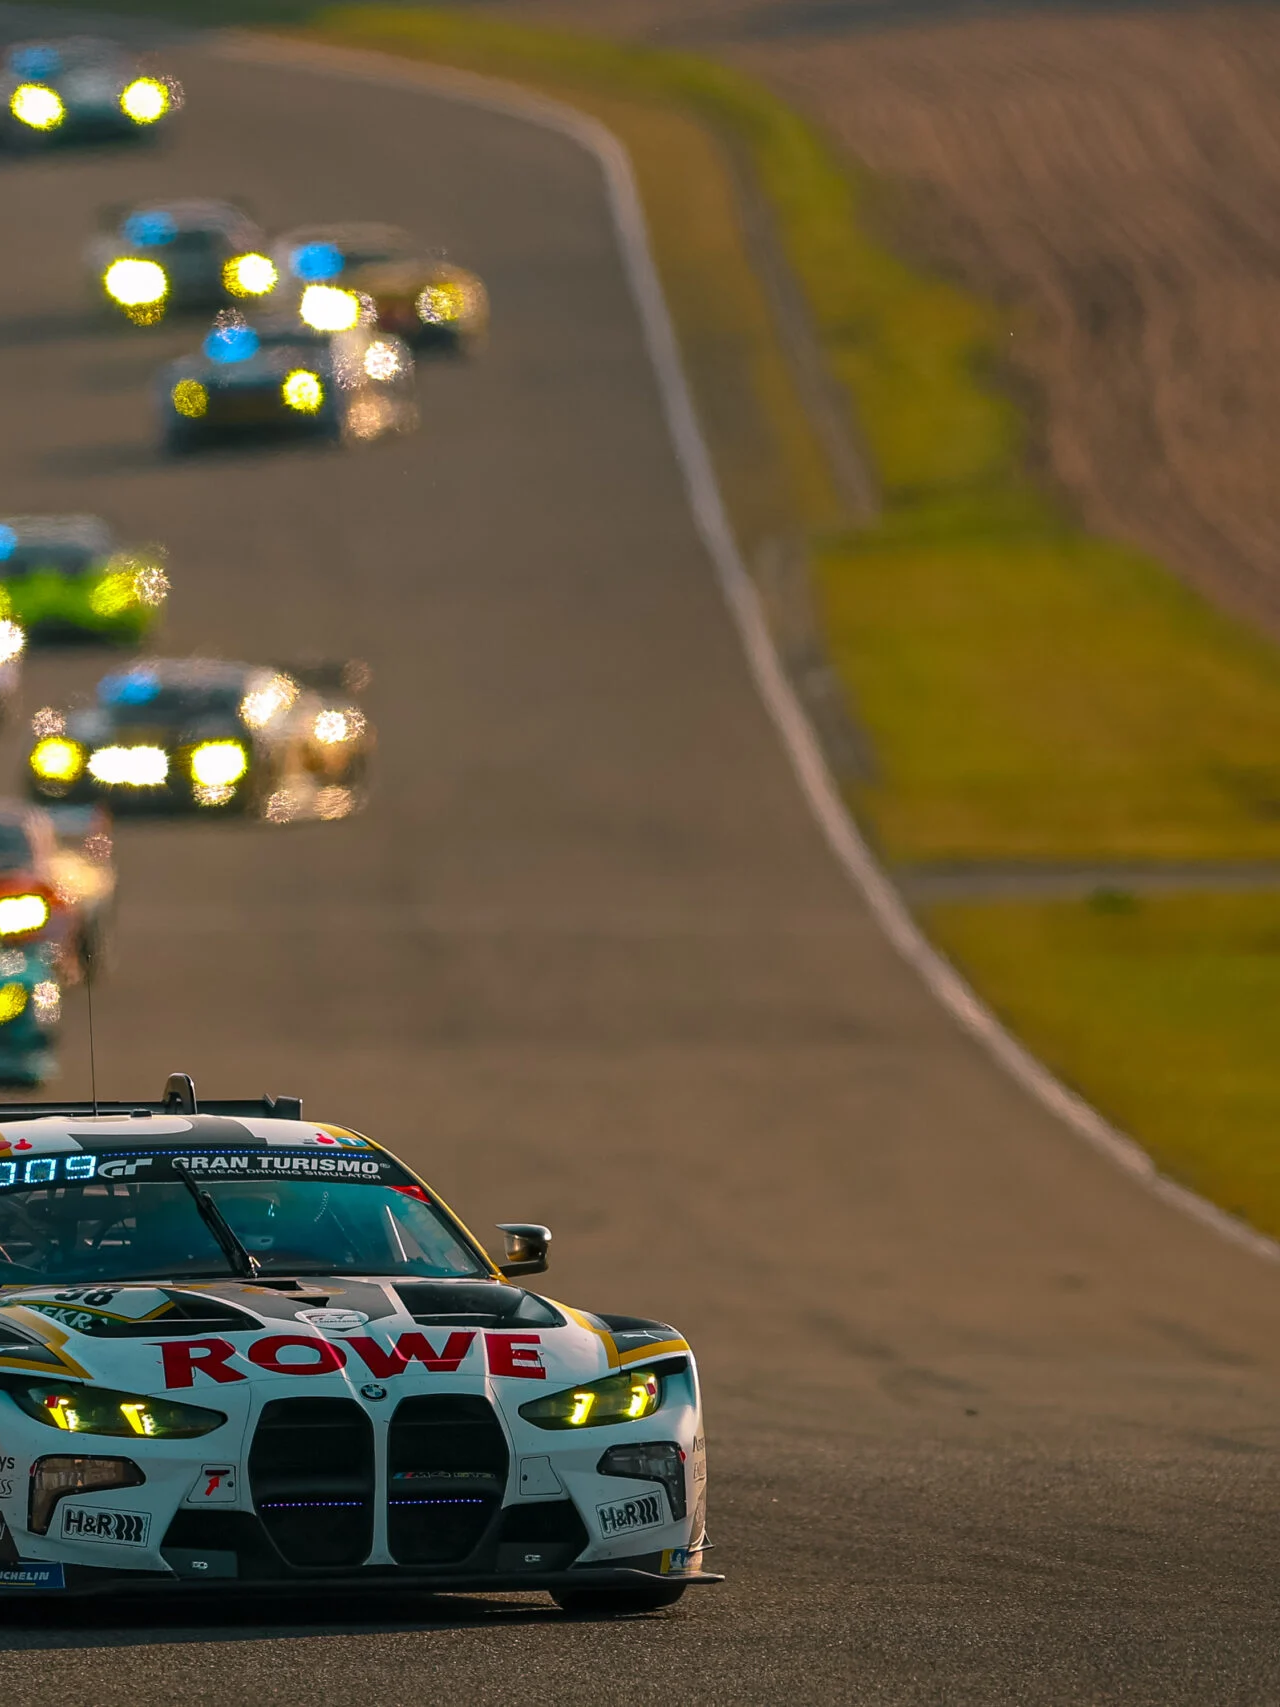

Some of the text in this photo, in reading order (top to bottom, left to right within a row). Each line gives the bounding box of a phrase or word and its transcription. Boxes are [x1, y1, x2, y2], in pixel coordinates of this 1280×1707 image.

[172, 1156, 248, 1169] GRAN
[304, 1169, 382, 1180] SIMULATOR
[142, 1331, 547, 1389] ROWE
[64, 1508, 116, 1537] H&R
[600, 1500, 641, 1533] H&R
